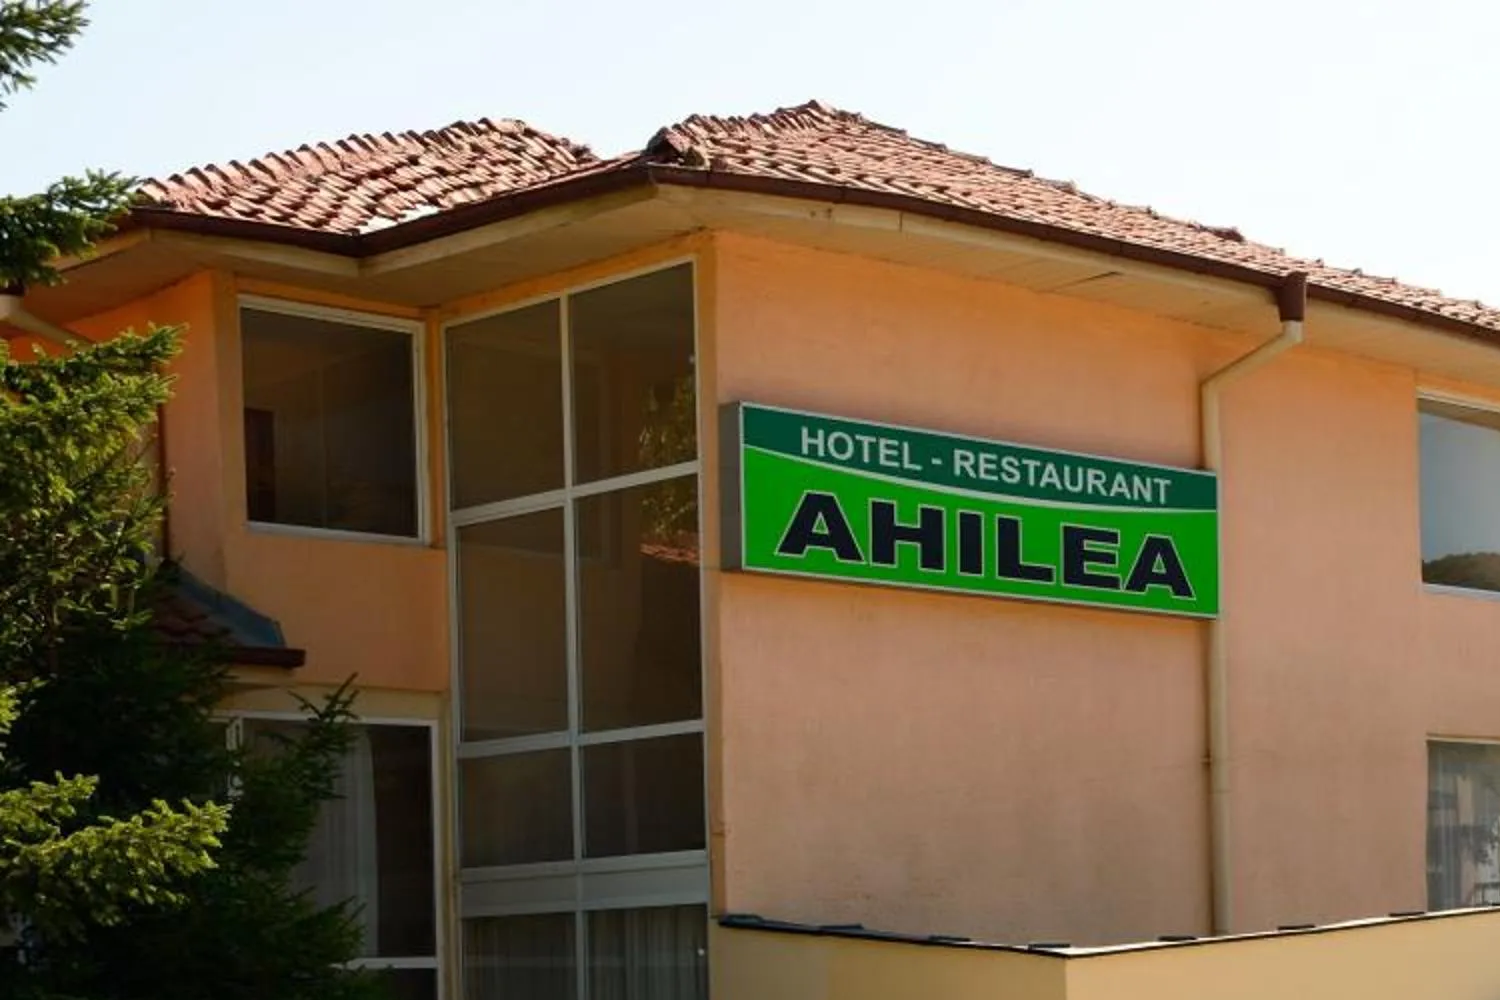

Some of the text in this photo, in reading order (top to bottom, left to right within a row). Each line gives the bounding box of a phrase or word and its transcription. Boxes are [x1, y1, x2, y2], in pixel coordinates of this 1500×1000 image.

[801, 426, 922, 472] HOTEL
[954, 449, 1171, 504] RESTAURANT
[774, 490, 1196, 599] AHILEA
